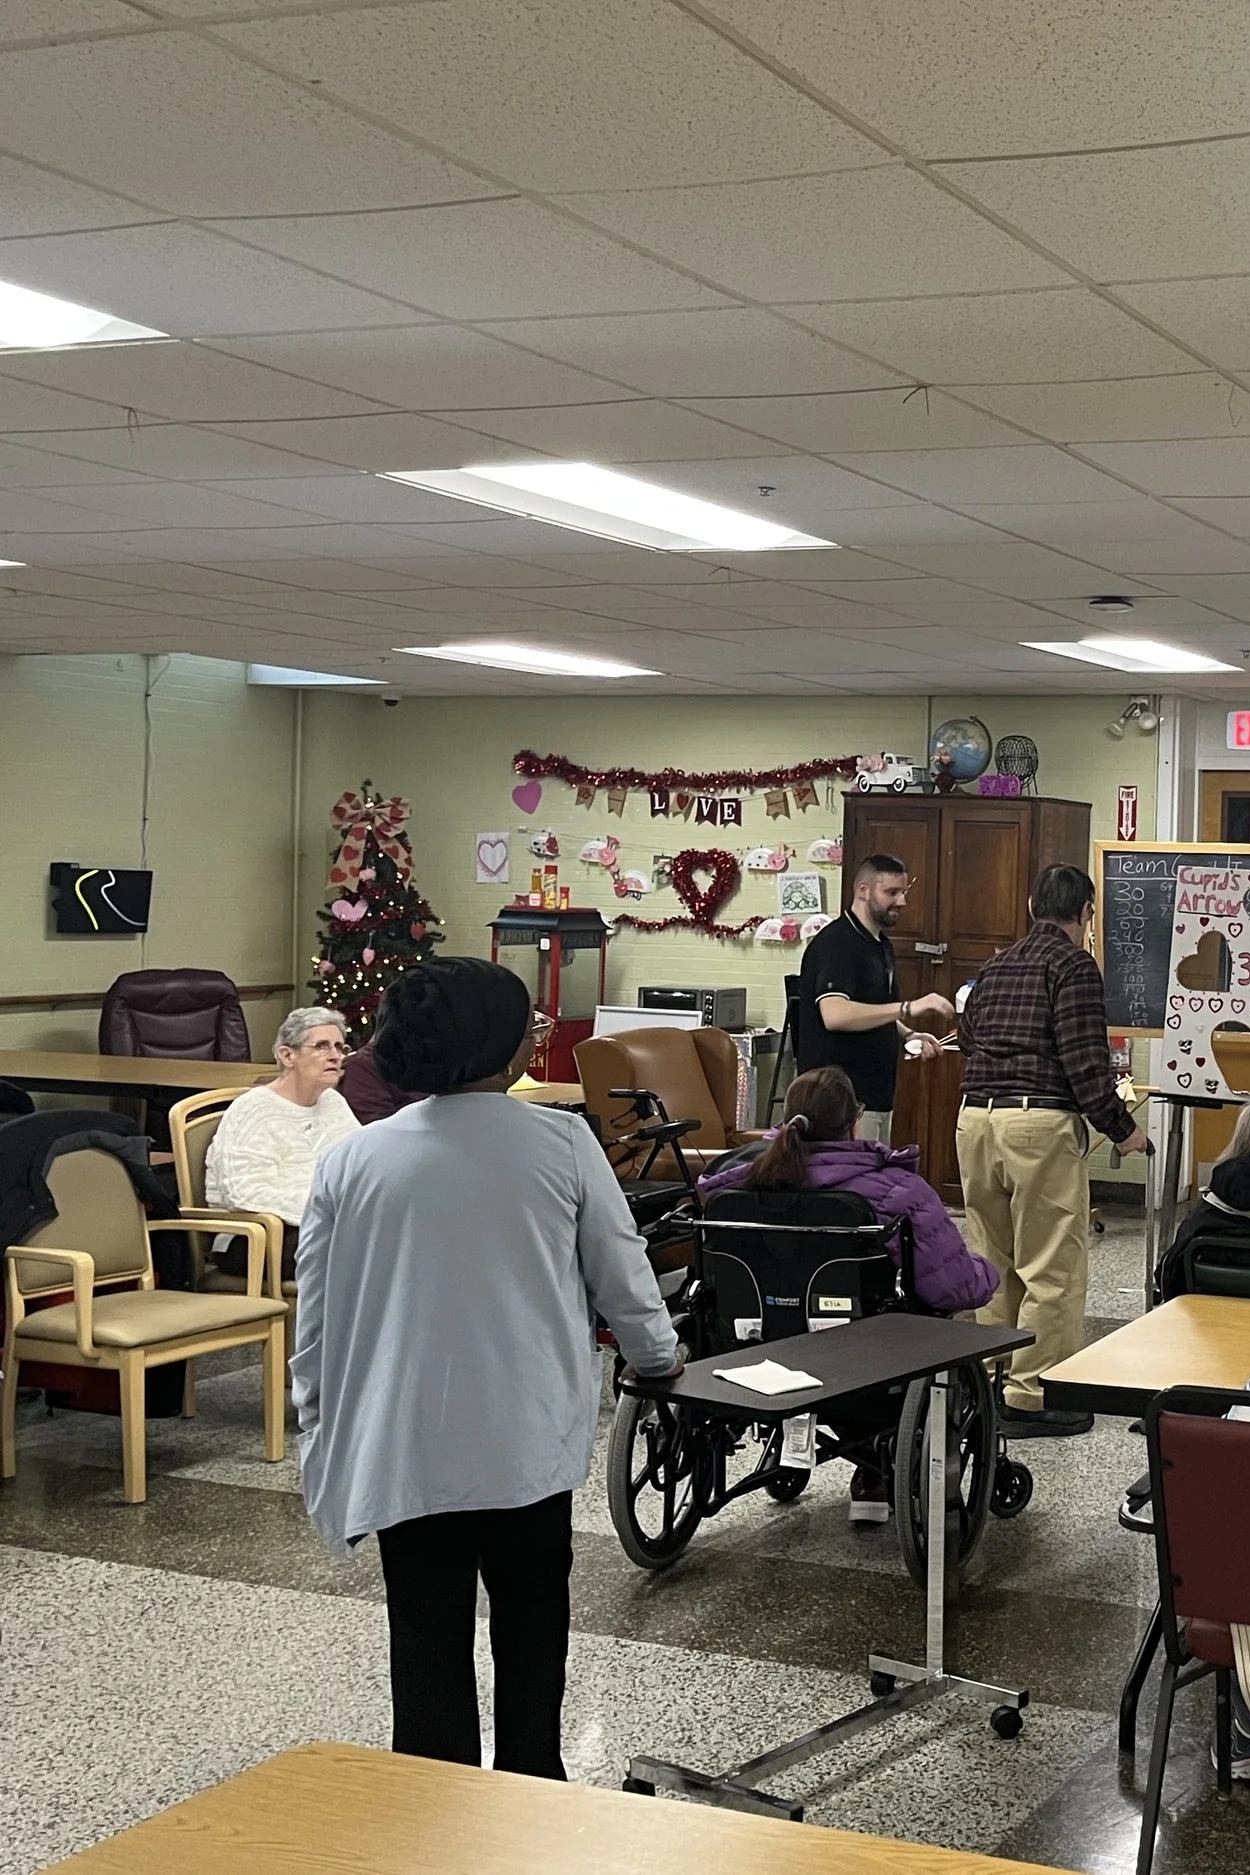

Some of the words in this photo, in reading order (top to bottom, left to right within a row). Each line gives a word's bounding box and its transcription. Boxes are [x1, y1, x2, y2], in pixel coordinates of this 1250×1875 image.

[1121, 791, 1134, 799] FIRE
[1107, 855, 1168, 876] Team
[1179, 867, 1241, 892] Cupid's
[1113, 881, 1145, 901] 30
[1176, 889, 1244, 916] Arrow
